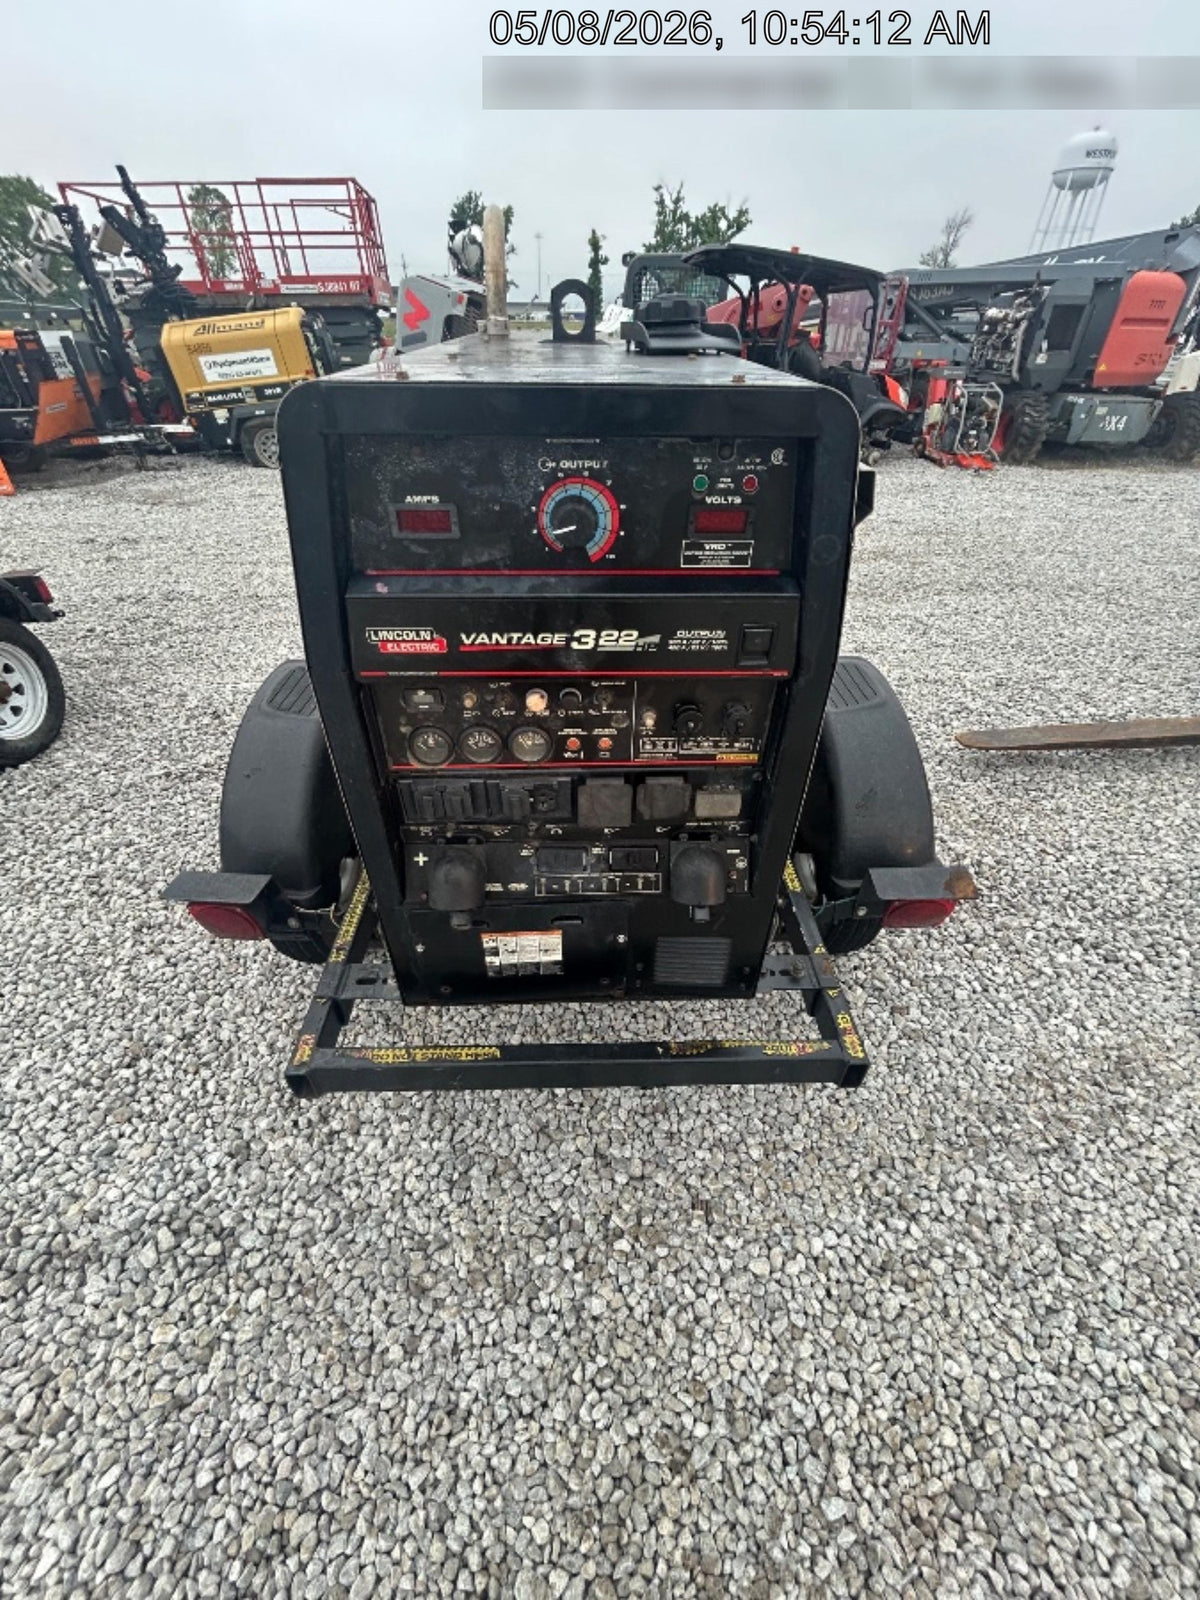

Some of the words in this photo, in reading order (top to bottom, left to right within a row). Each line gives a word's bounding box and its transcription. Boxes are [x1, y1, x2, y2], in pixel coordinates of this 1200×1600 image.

[193, 318, 265, 336] Allmand
[705, 495, 742, 504] VOLTS
[370, 630, 432, 641] LINCOLN
[460, 632, 567, 644] VANTAGE
[570, 628, 639, 650] 322
[386, 643, 440, 651] ELECTRIC
